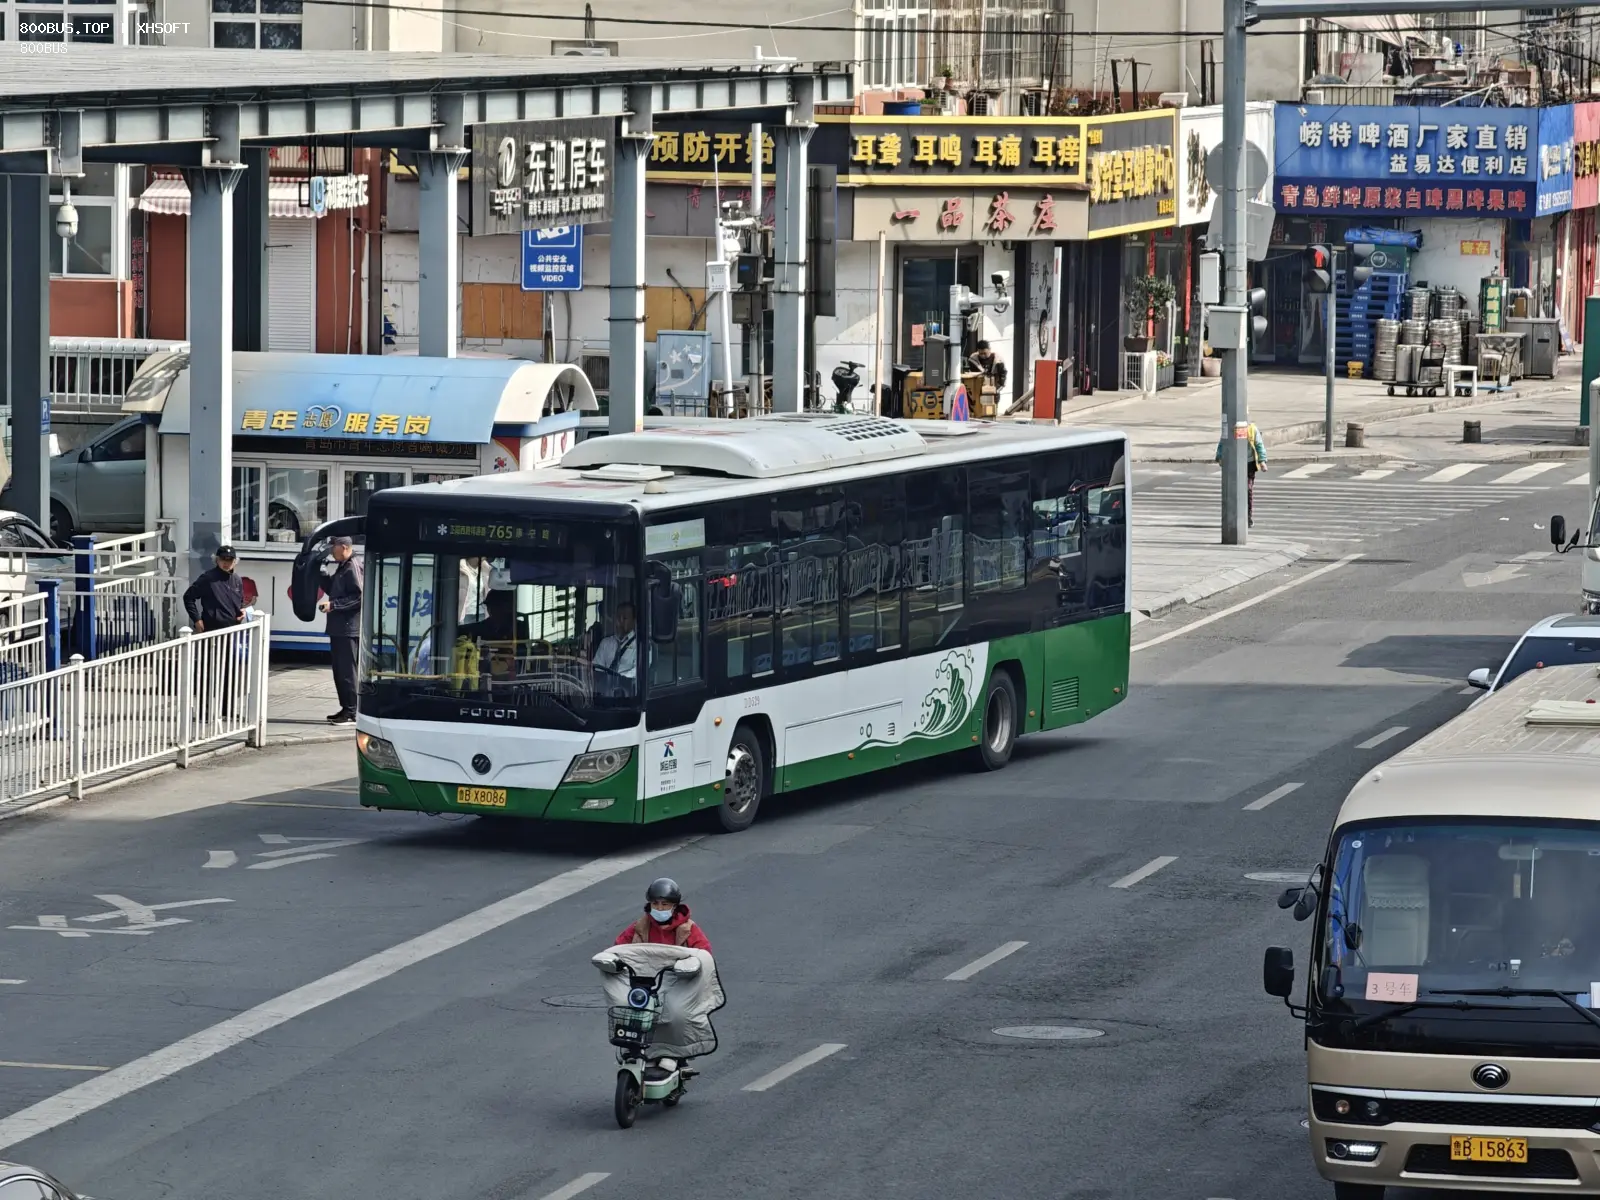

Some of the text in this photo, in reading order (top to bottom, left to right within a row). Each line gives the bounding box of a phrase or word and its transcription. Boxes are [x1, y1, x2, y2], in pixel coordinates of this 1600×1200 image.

[650, 130, 776, 165] 预防开始
[1299, 121, 1528, 151] 崂特啤酒厂家直销
[851, 132, 902, 167] 耳聋
[913, 132, 962, 167] 耳鸣
[973, 133, 1022, 167] 耳痛
[1032, 134, 1080, 167] 耳痒
[528, 137, 606, 194] 东驰房车
[1389, 153, 1527, 175] 益易达便利店
[1280, 184, 1527, 212] 青岛鲜啤原浆白啤黑啤果啤
[894, 191, 1058, 232] 一品茶庄
[529, 264, 575, 273] 视频监控区域
[537, 255, 568, 263] 公共安全
[541, 274, 564, 282] VIDEO
[487, 524, 513, 539] 765
[459, 707, 518, 719] FOTON
